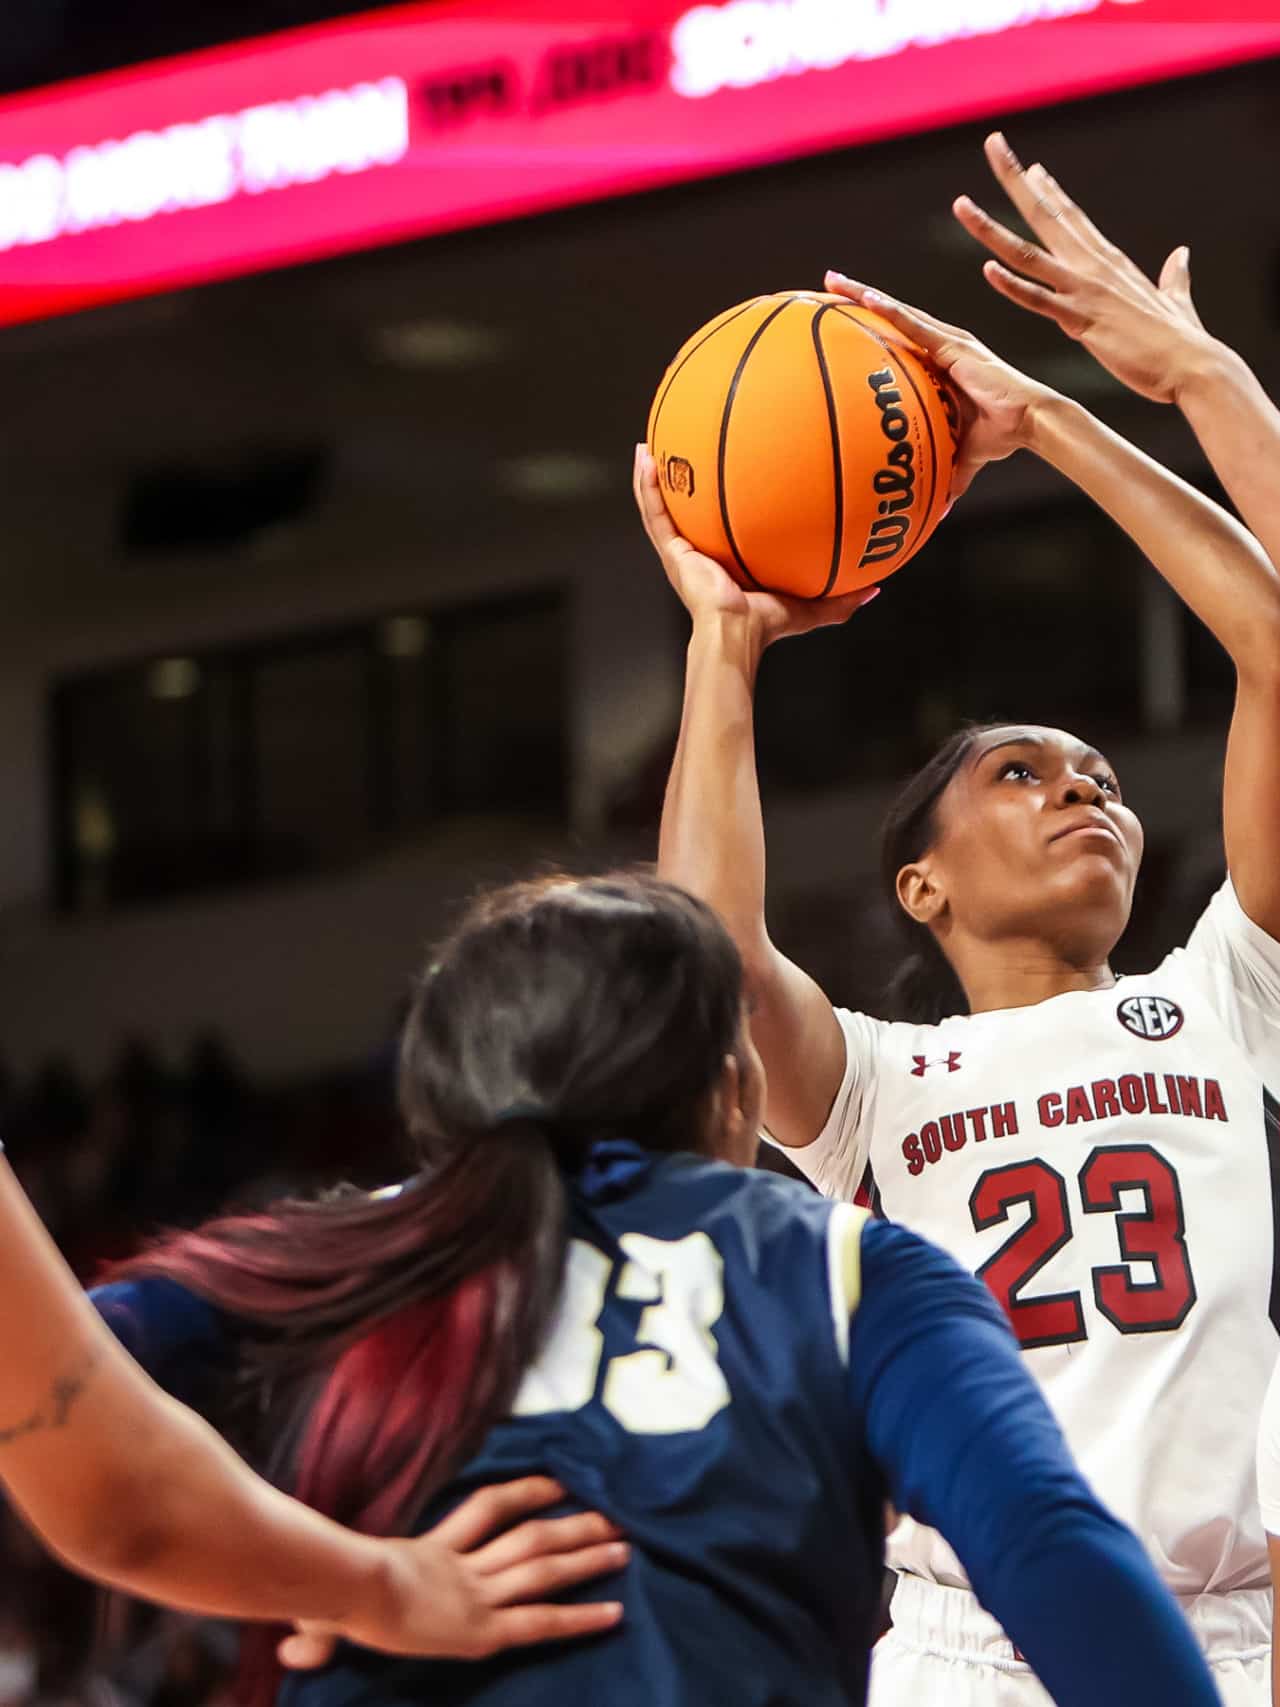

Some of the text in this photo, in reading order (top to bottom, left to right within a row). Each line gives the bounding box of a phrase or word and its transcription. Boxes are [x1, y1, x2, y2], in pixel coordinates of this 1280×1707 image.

[857, 368, 915, 568] Wilson
[1119, 997, 1180, 1037] SEC
[901, 1072, 1229, 1176] SOUTH CAROLINA
[968, 1143, 1198, 1351] 23
